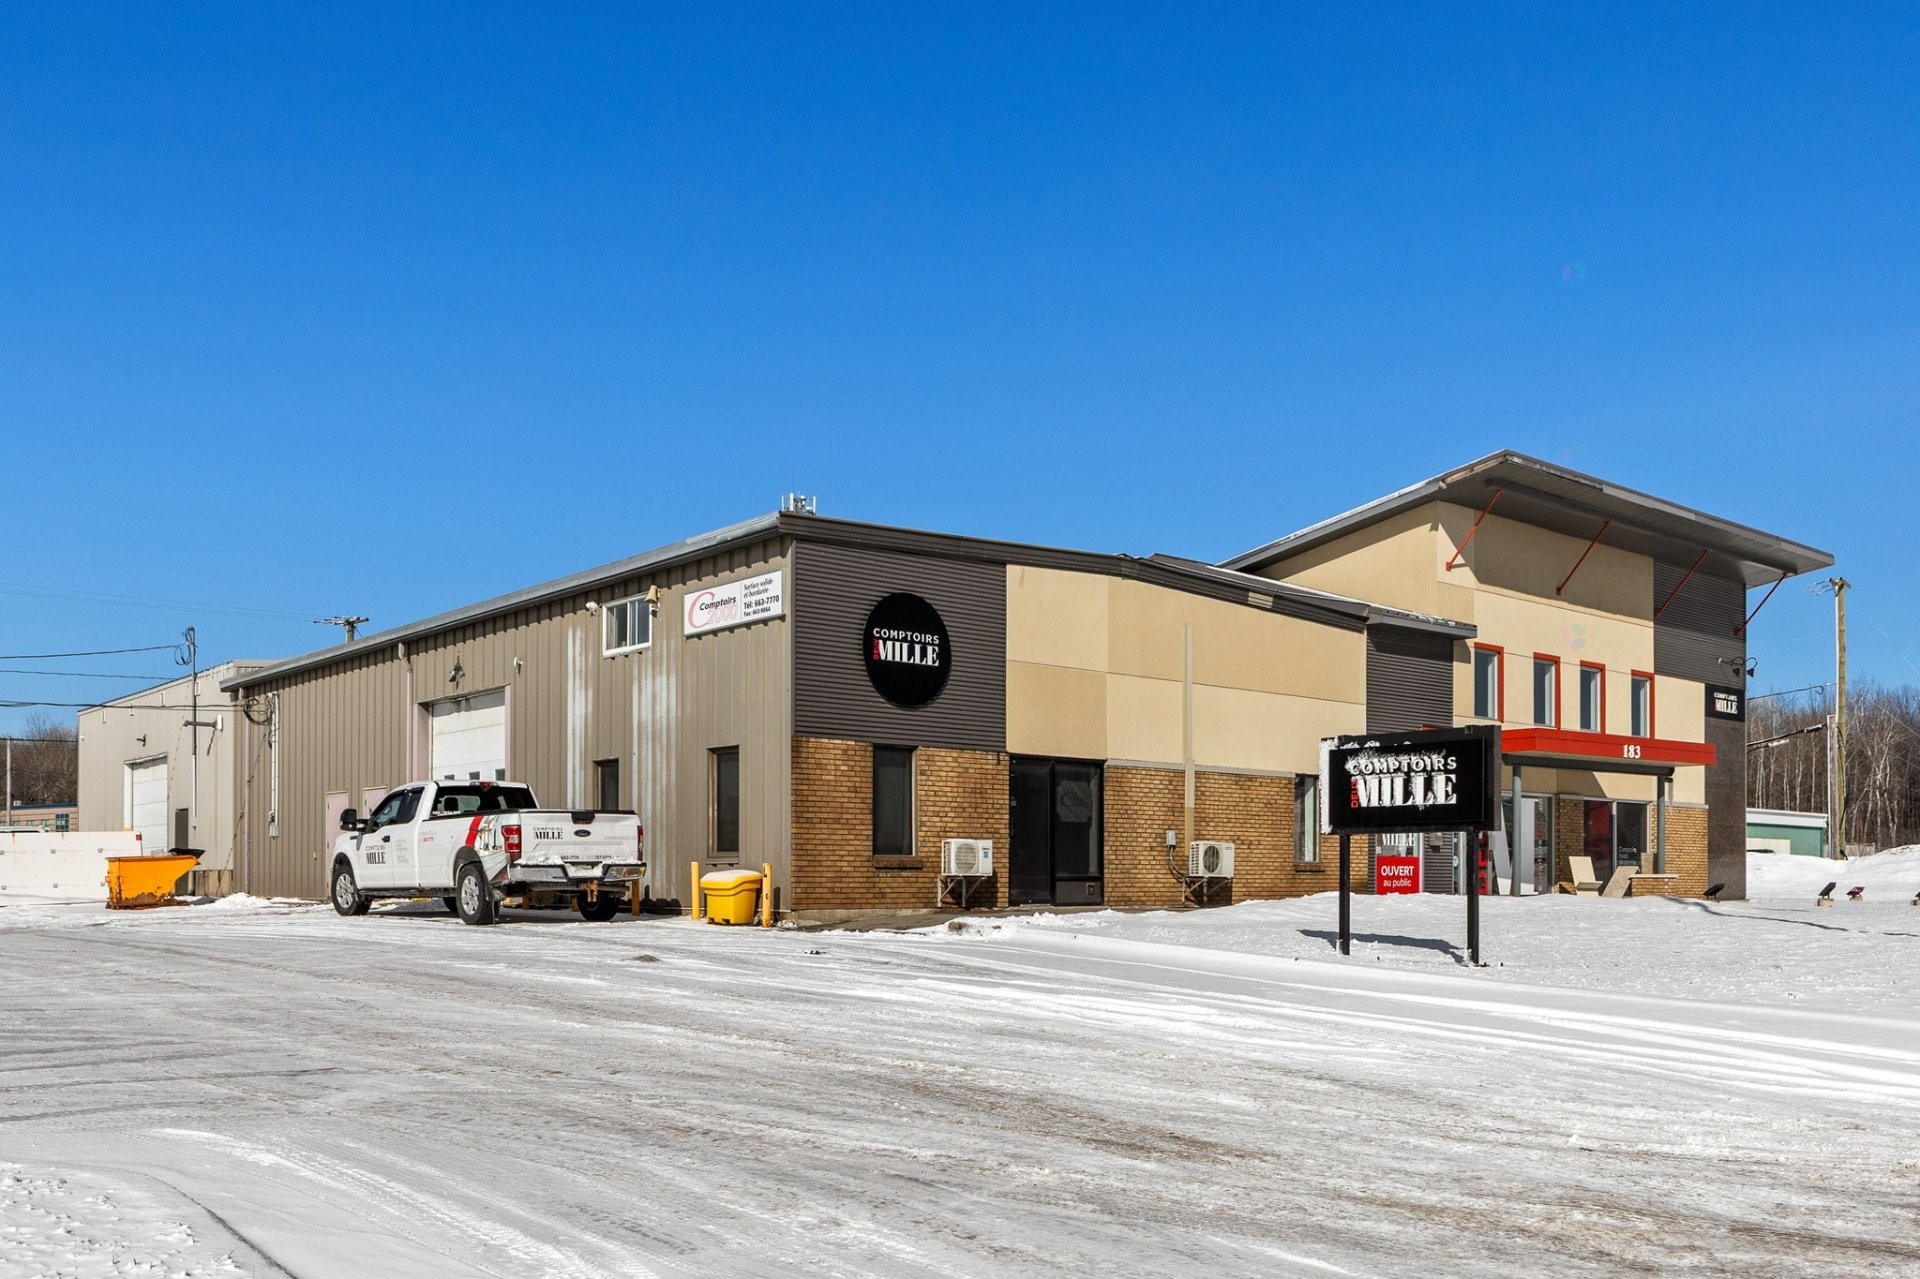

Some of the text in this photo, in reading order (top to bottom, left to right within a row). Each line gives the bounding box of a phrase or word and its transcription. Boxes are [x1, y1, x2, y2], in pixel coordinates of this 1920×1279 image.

[699, 596, 737, 611] Comptoirs
[754, 595, 780, 607] 663-7770
[873, 627, 940, 645] COMPTOIRS
[879, 639, 940, 667] MILLE
[1715, 698, 1738, 714] MILLE
[1622, 744, 1641, 759] 183
[1350, 756, 1457, 775] COMPTOIRS
[1356, 773, 1457, 808] MILLE
[533, 831, 564, 840] MILLE
[366, 851, 387, 865] MILLE
[1381, 865, 1415, 877] OUVERT
[1392, 877, 1412, 888] public
